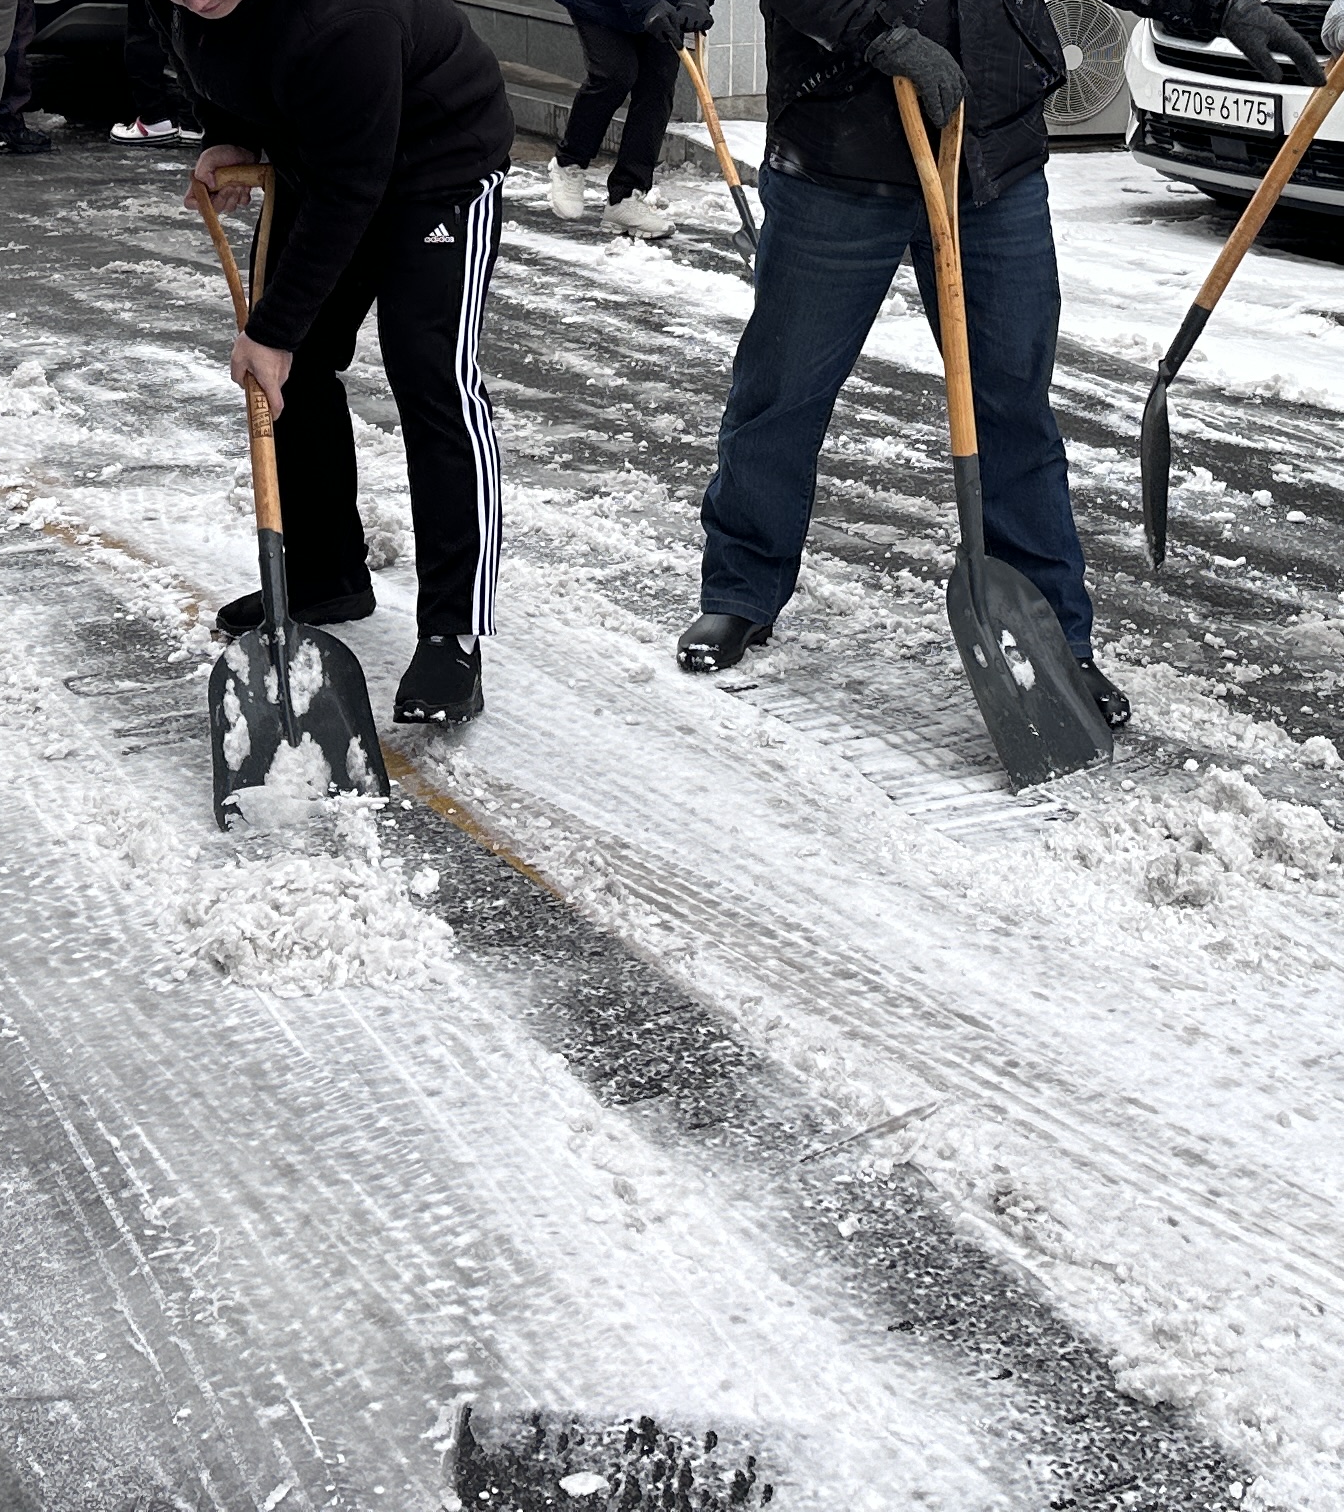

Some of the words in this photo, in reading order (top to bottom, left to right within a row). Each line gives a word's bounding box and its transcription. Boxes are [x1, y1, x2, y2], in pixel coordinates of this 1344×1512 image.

[1171, 88, 1216, 117] 270우
[1219, 95, 1268, 126] 6175
[424, 235, 455, 243] adidas
